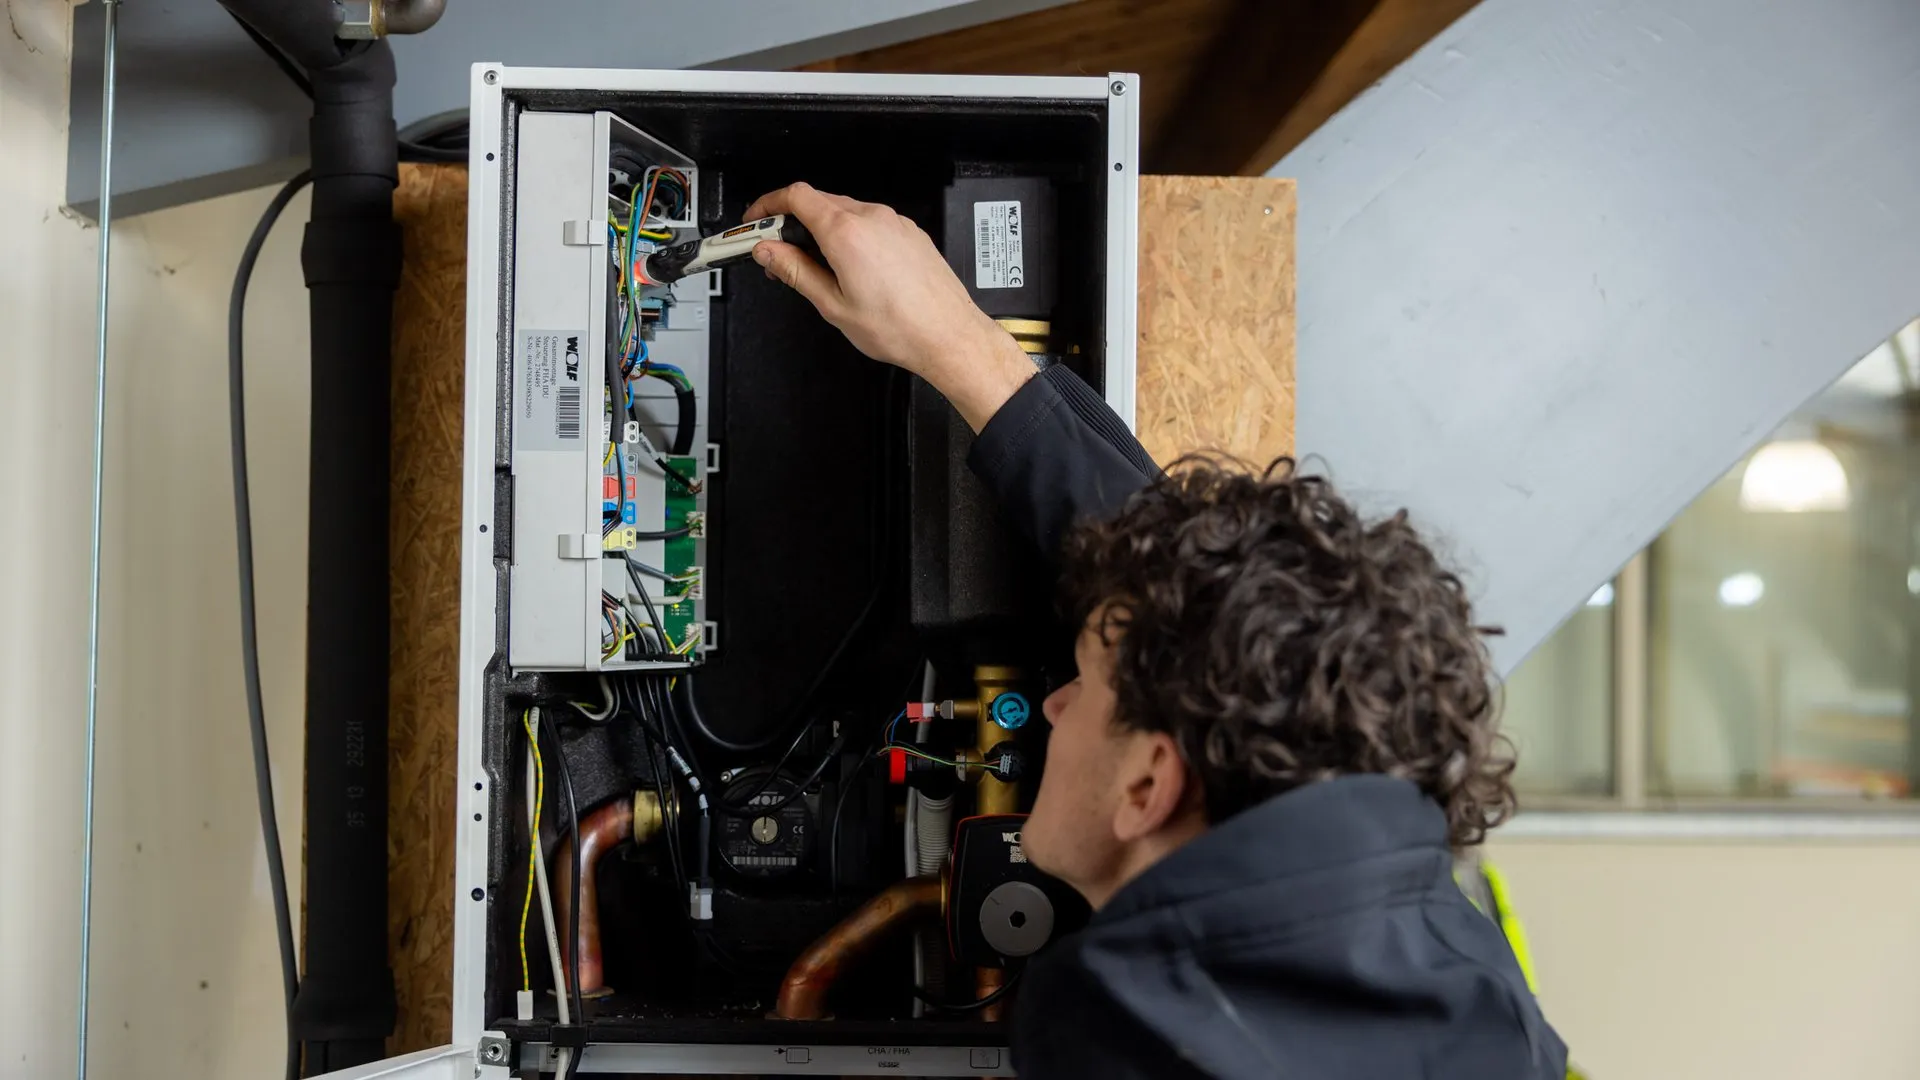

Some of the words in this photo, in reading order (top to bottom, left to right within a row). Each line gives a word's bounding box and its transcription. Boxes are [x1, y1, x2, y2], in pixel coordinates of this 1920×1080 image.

[1009, 206, 1018, 236] WOLF
[1010, 266, 1022, 285] CE
[542, 336, 550, 366] Steuerung
[550, 336, 559, 386] Gesamtmontage
[566, 336, 579, 381] WOLF
[867, 1047, 886, 1055] CHA
[893, 1047, 911, 1055] FHA
